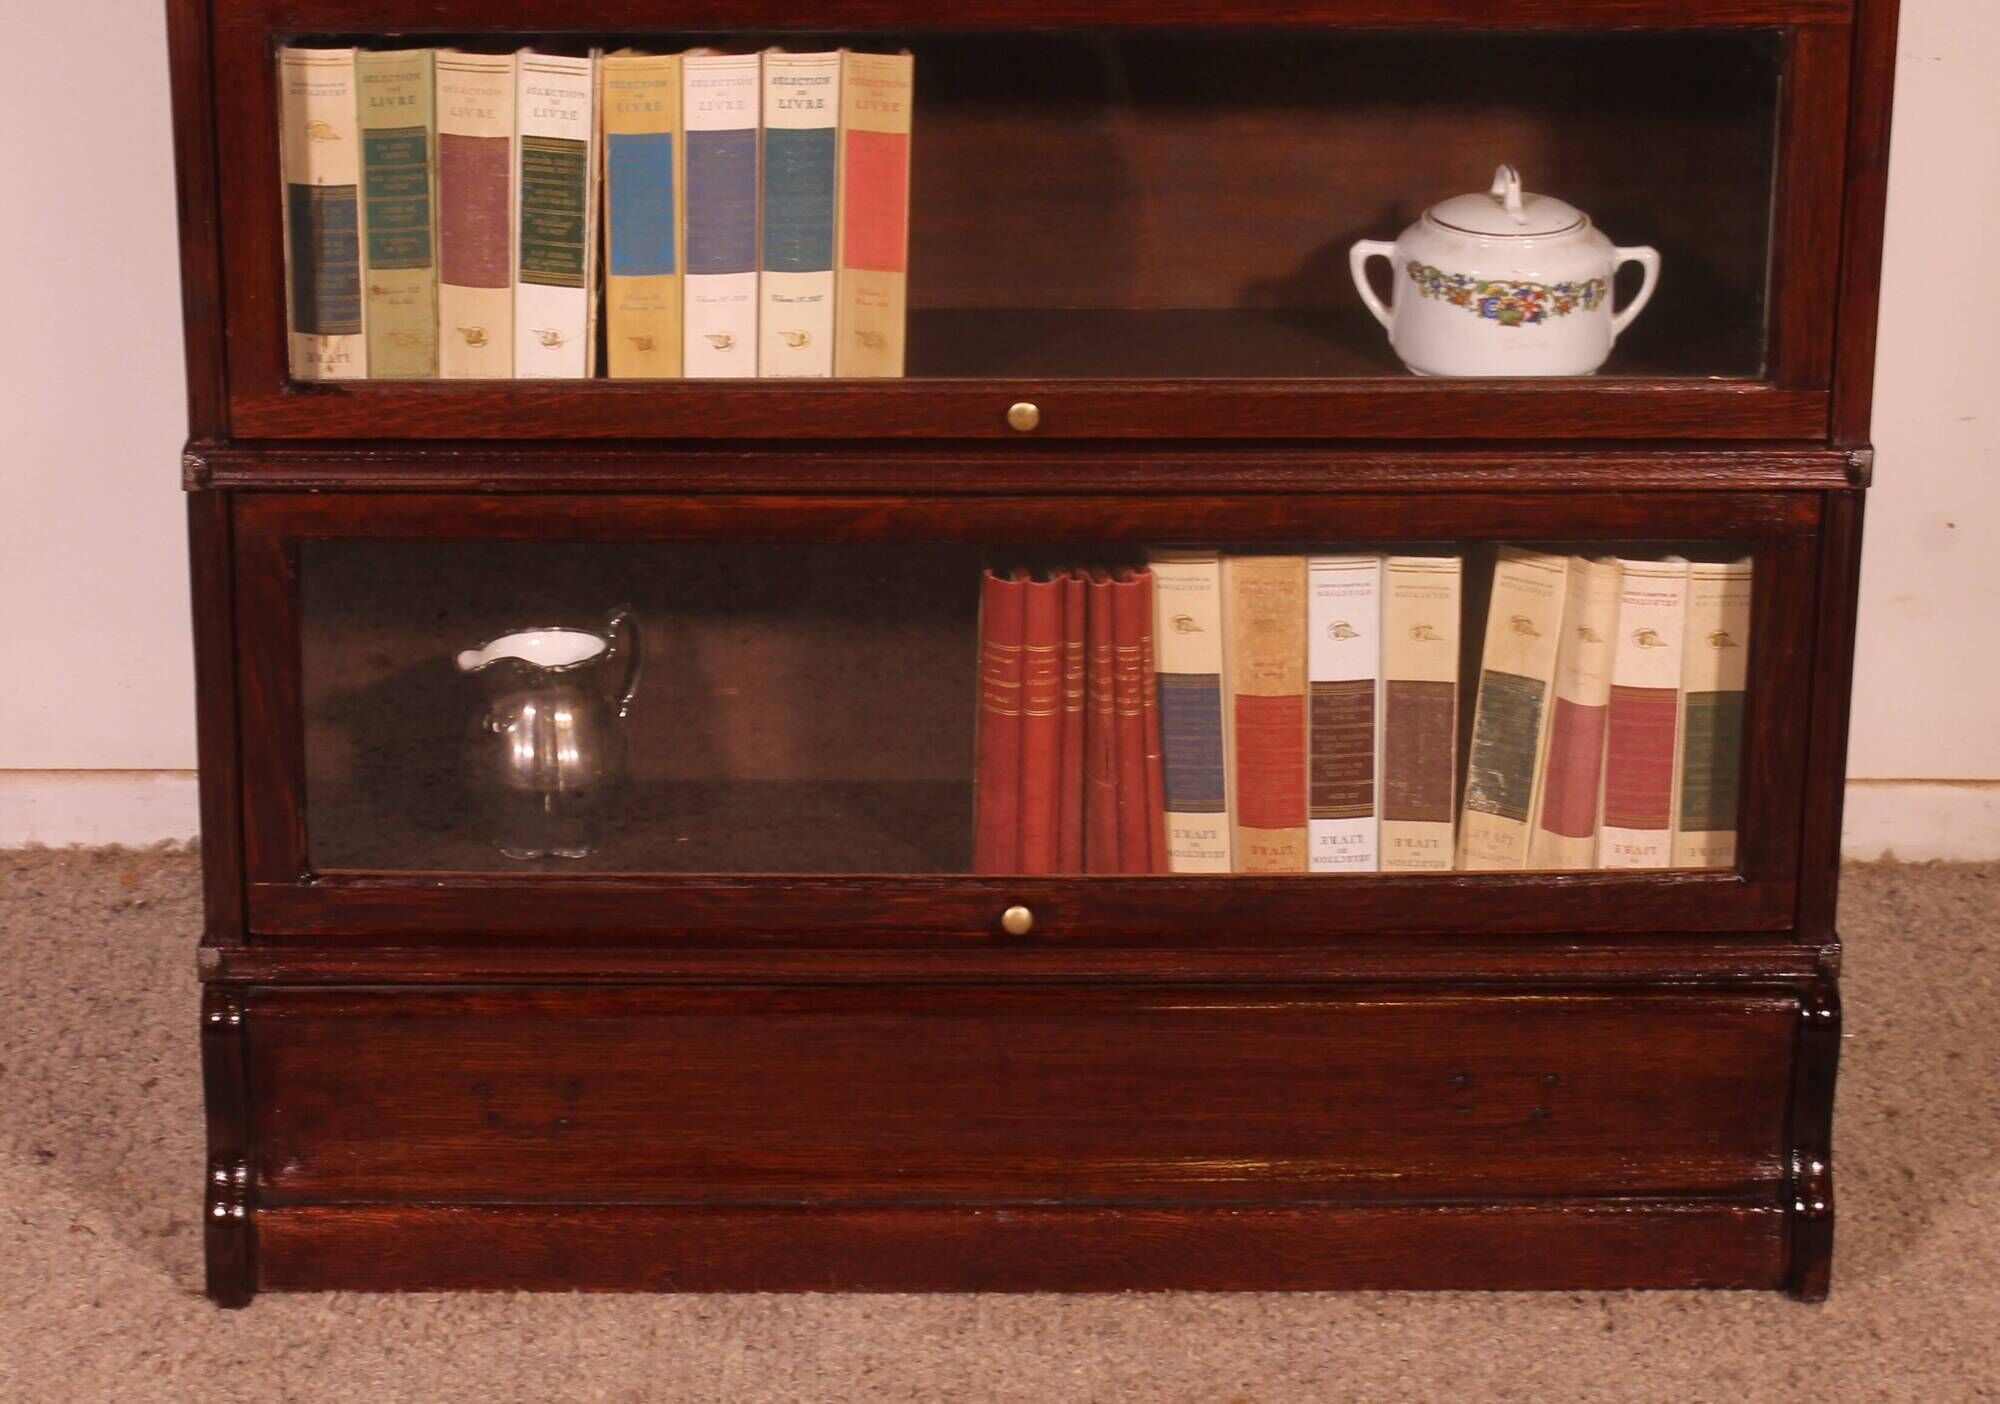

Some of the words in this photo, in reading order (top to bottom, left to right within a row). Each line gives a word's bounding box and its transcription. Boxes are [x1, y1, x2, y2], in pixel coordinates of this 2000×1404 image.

[370, 95, 416, 107] LIVRE
[699, 101, 744, 111] LIVRE
[778, 99, 824, 109] LIVRE
[855, 100, 900, 112] LIVRE
[616, 101, 663, 113] LIVRE
[450, 107, 495, 119] LIVRE
[533, 108, 579, 121] LIVRE
[1173, 829, 1216, 839] LIVRE
[1320, 835, 1364, 845] LIVRE
[1394, 839, 1438, 848] LIVRE
